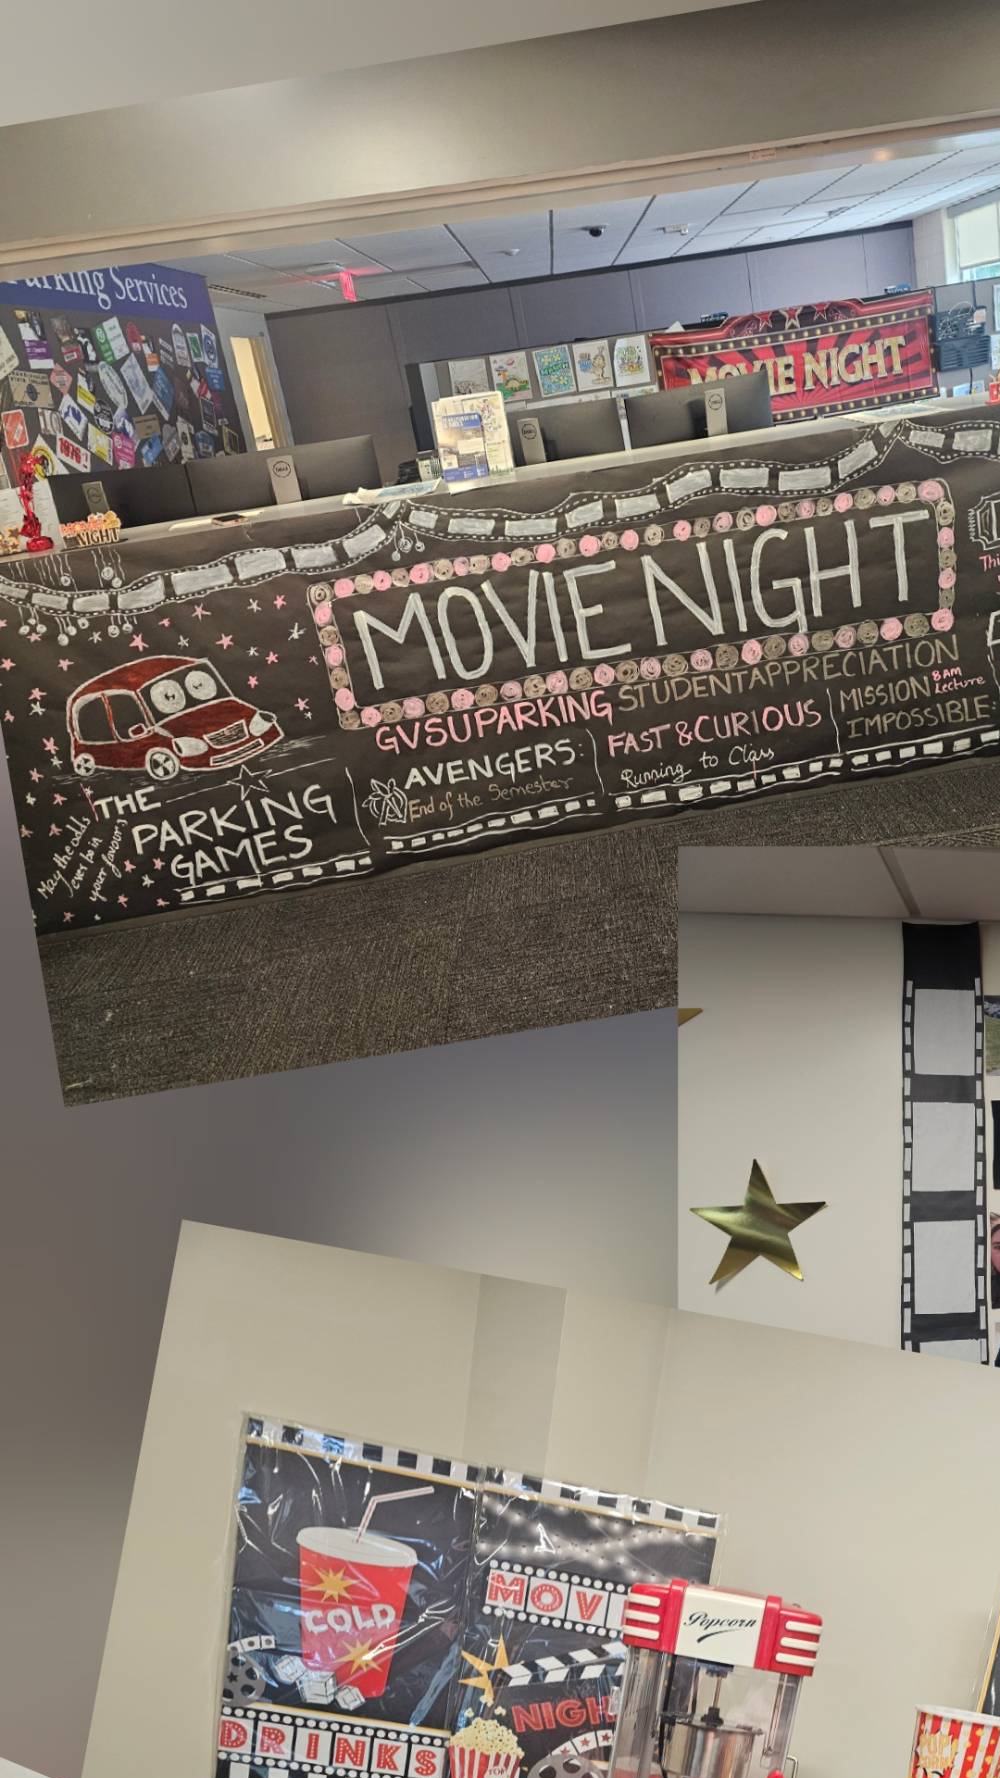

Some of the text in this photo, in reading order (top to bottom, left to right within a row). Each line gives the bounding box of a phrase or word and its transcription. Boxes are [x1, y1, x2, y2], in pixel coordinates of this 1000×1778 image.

[5, 265, 188, 310] arking Services
[803, 335, 905, 391] NIGHT
[353, 509, 931, 691] MOVIE NIGHT
[748, 633, 959, 691] APPRECIATION
[839, 675, 932, 714] MISSION
[608, 722, 672, 759] FAST
[693, 698, 823, 744] CURIOUS
[620, 743, 776, 789] Running to Class
[92, 785, 162, 820] THE
[131, 784, 339, 856] PARKING
[408, 774, 574, 823] End of the Semester
[36, 869, 74, 900] May
[65, 815, 92, 848] odds
[170, 824, 314, 888] GAMES
[304, 1603, 397, 1634] COLD
[487, 1571, 605, 1622] MOV
[683, 1611, 758, 1631] Popcorn
[219, 1719, 438, 1776] DRINKS
